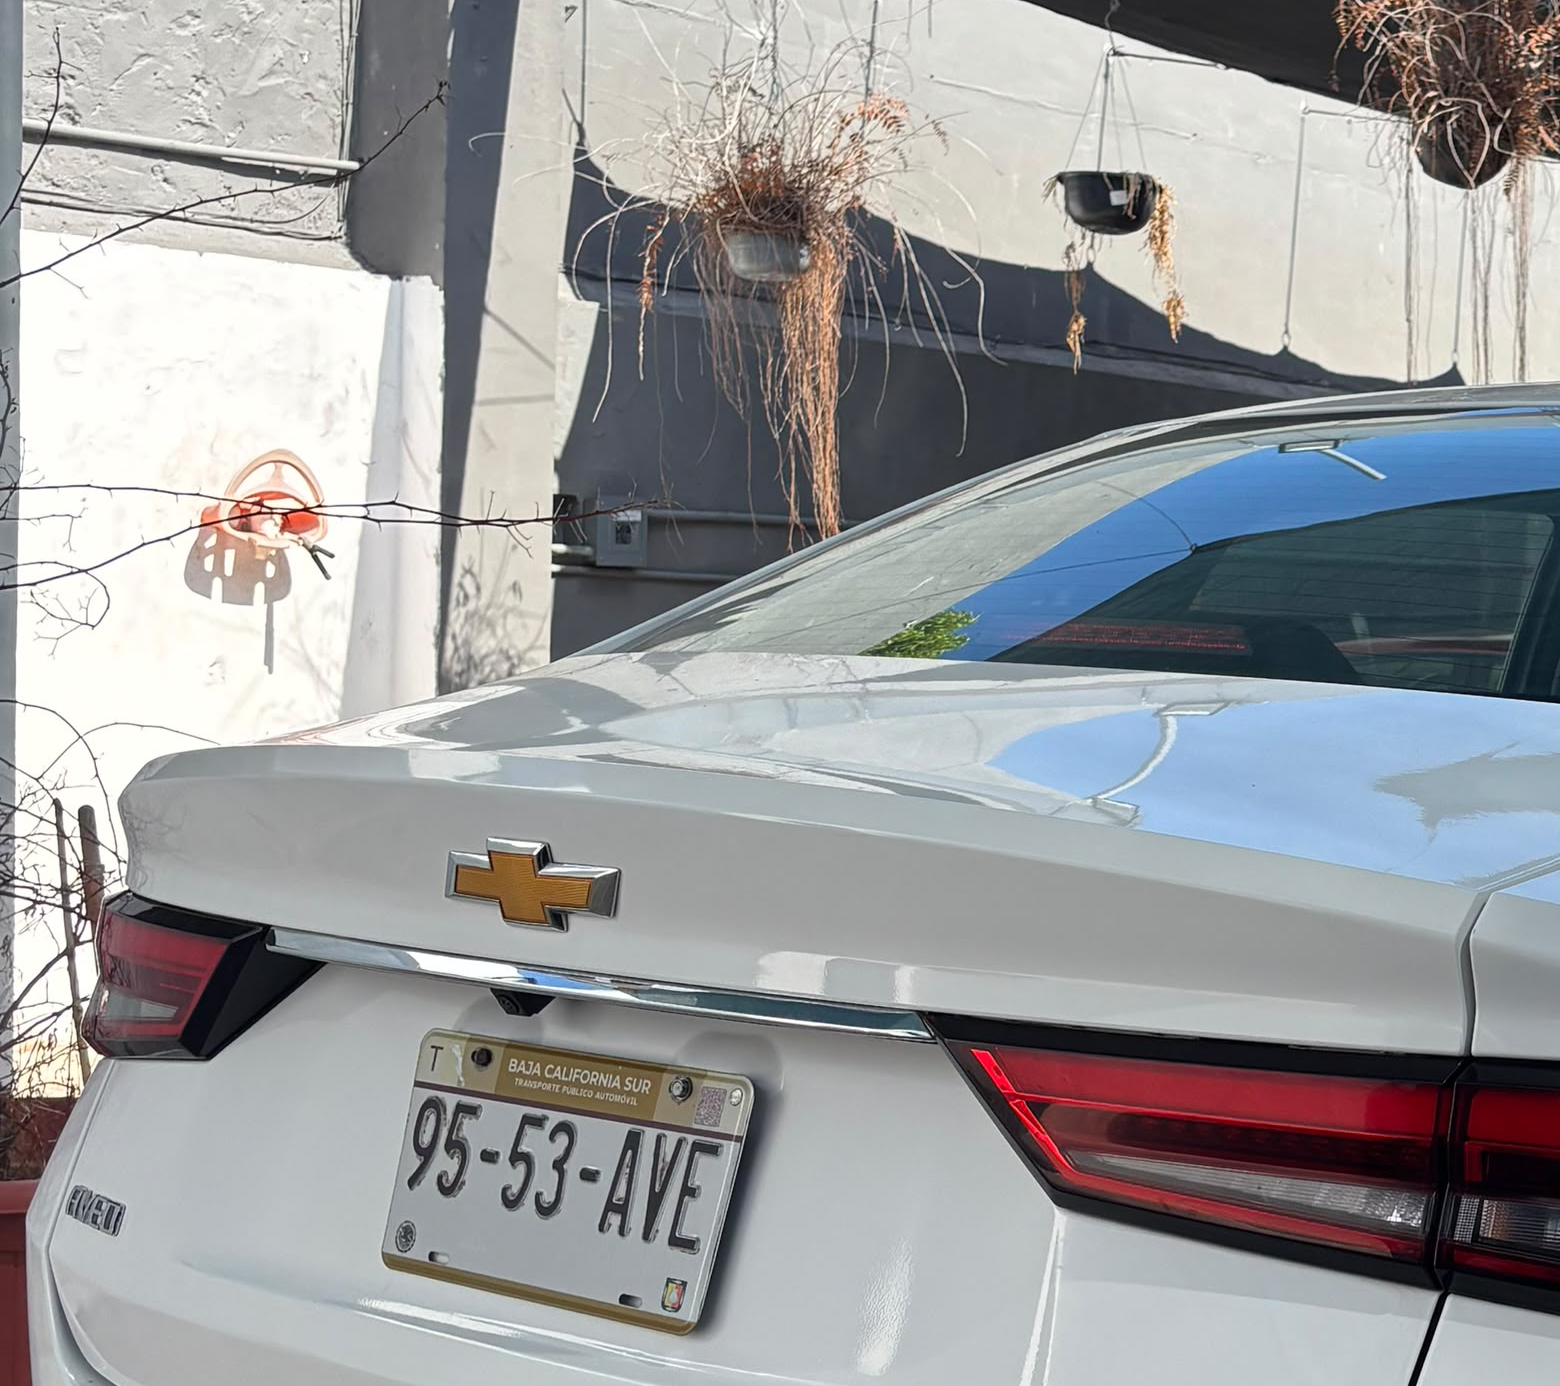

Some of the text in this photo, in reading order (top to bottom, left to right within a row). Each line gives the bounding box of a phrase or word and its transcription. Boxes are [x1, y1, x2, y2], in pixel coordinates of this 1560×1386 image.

[430, 1045, 444, 1072] T
[508, 1058, 652, 1094] BAJA CALIFORNIA SUR
[514, 1077, 561, 1093] TRANSPORTE
[407, 1096, 724, 1255] 95-53-AVE
